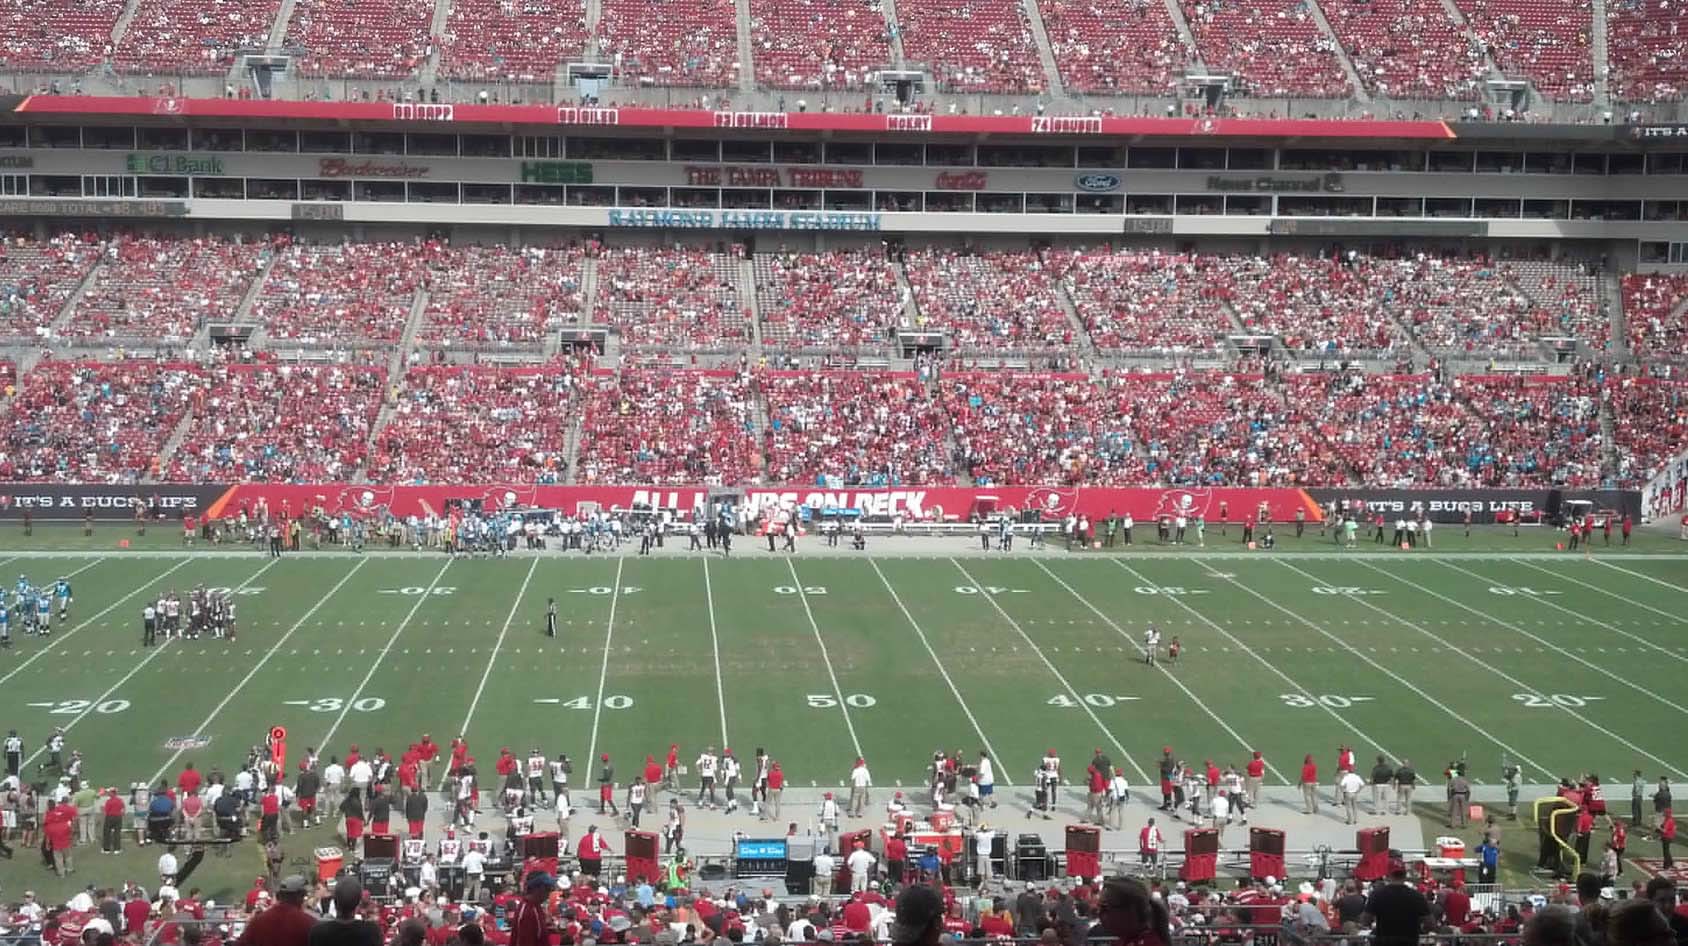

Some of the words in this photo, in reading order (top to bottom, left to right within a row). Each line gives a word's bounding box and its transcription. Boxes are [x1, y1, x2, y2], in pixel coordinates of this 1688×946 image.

[521, 161, 593, 183] HESS
[684, 166, 721, 185] THE
[726, 168, 782, 187] TAMPA
[787, 169, 863, 188] TRIBUNE
[608, 211, 713, 225] RAYMOND
[790, 213, 880, 229] STADIUM
[15, 496, 53, 508] IT'S
[60, 497, 75, 508] A
[49, 700, 131, 714] 20
[309, 698, 386, 712] 30
[563, 695, 634, 709] 40
[807, 694, 877, 708] 50
[1046, 694, 1116, 708] 40
[1280, 694, 1352, 708] 30
[1512, 694, 1588, 708] 20
